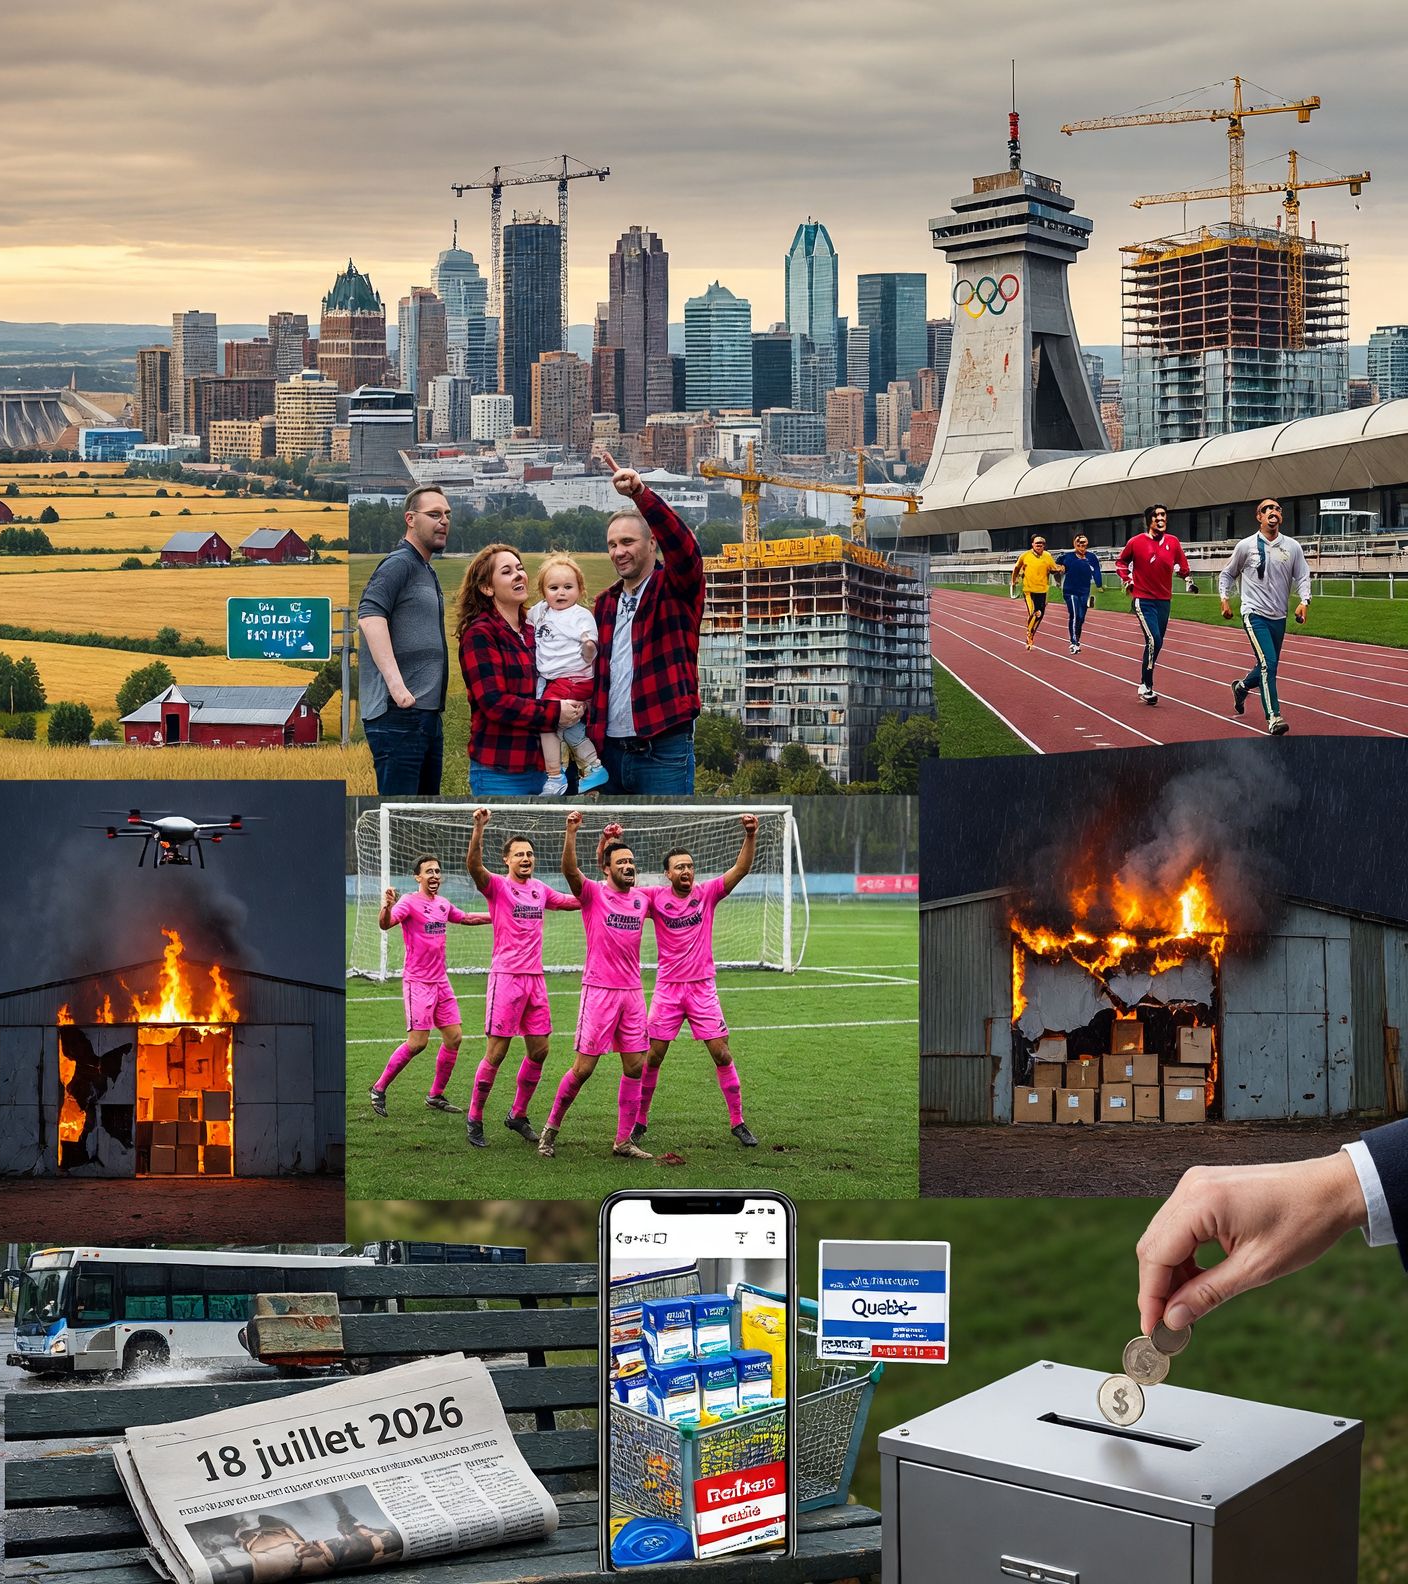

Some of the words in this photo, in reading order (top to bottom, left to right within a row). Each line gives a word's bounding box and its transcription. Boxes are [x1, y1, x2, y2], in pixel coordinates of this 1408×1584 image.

[196, 1446, 247, 1482] 18
[252, 1422, 365, 1480] juillet
[368, 1396, 464, 1446] 2026
